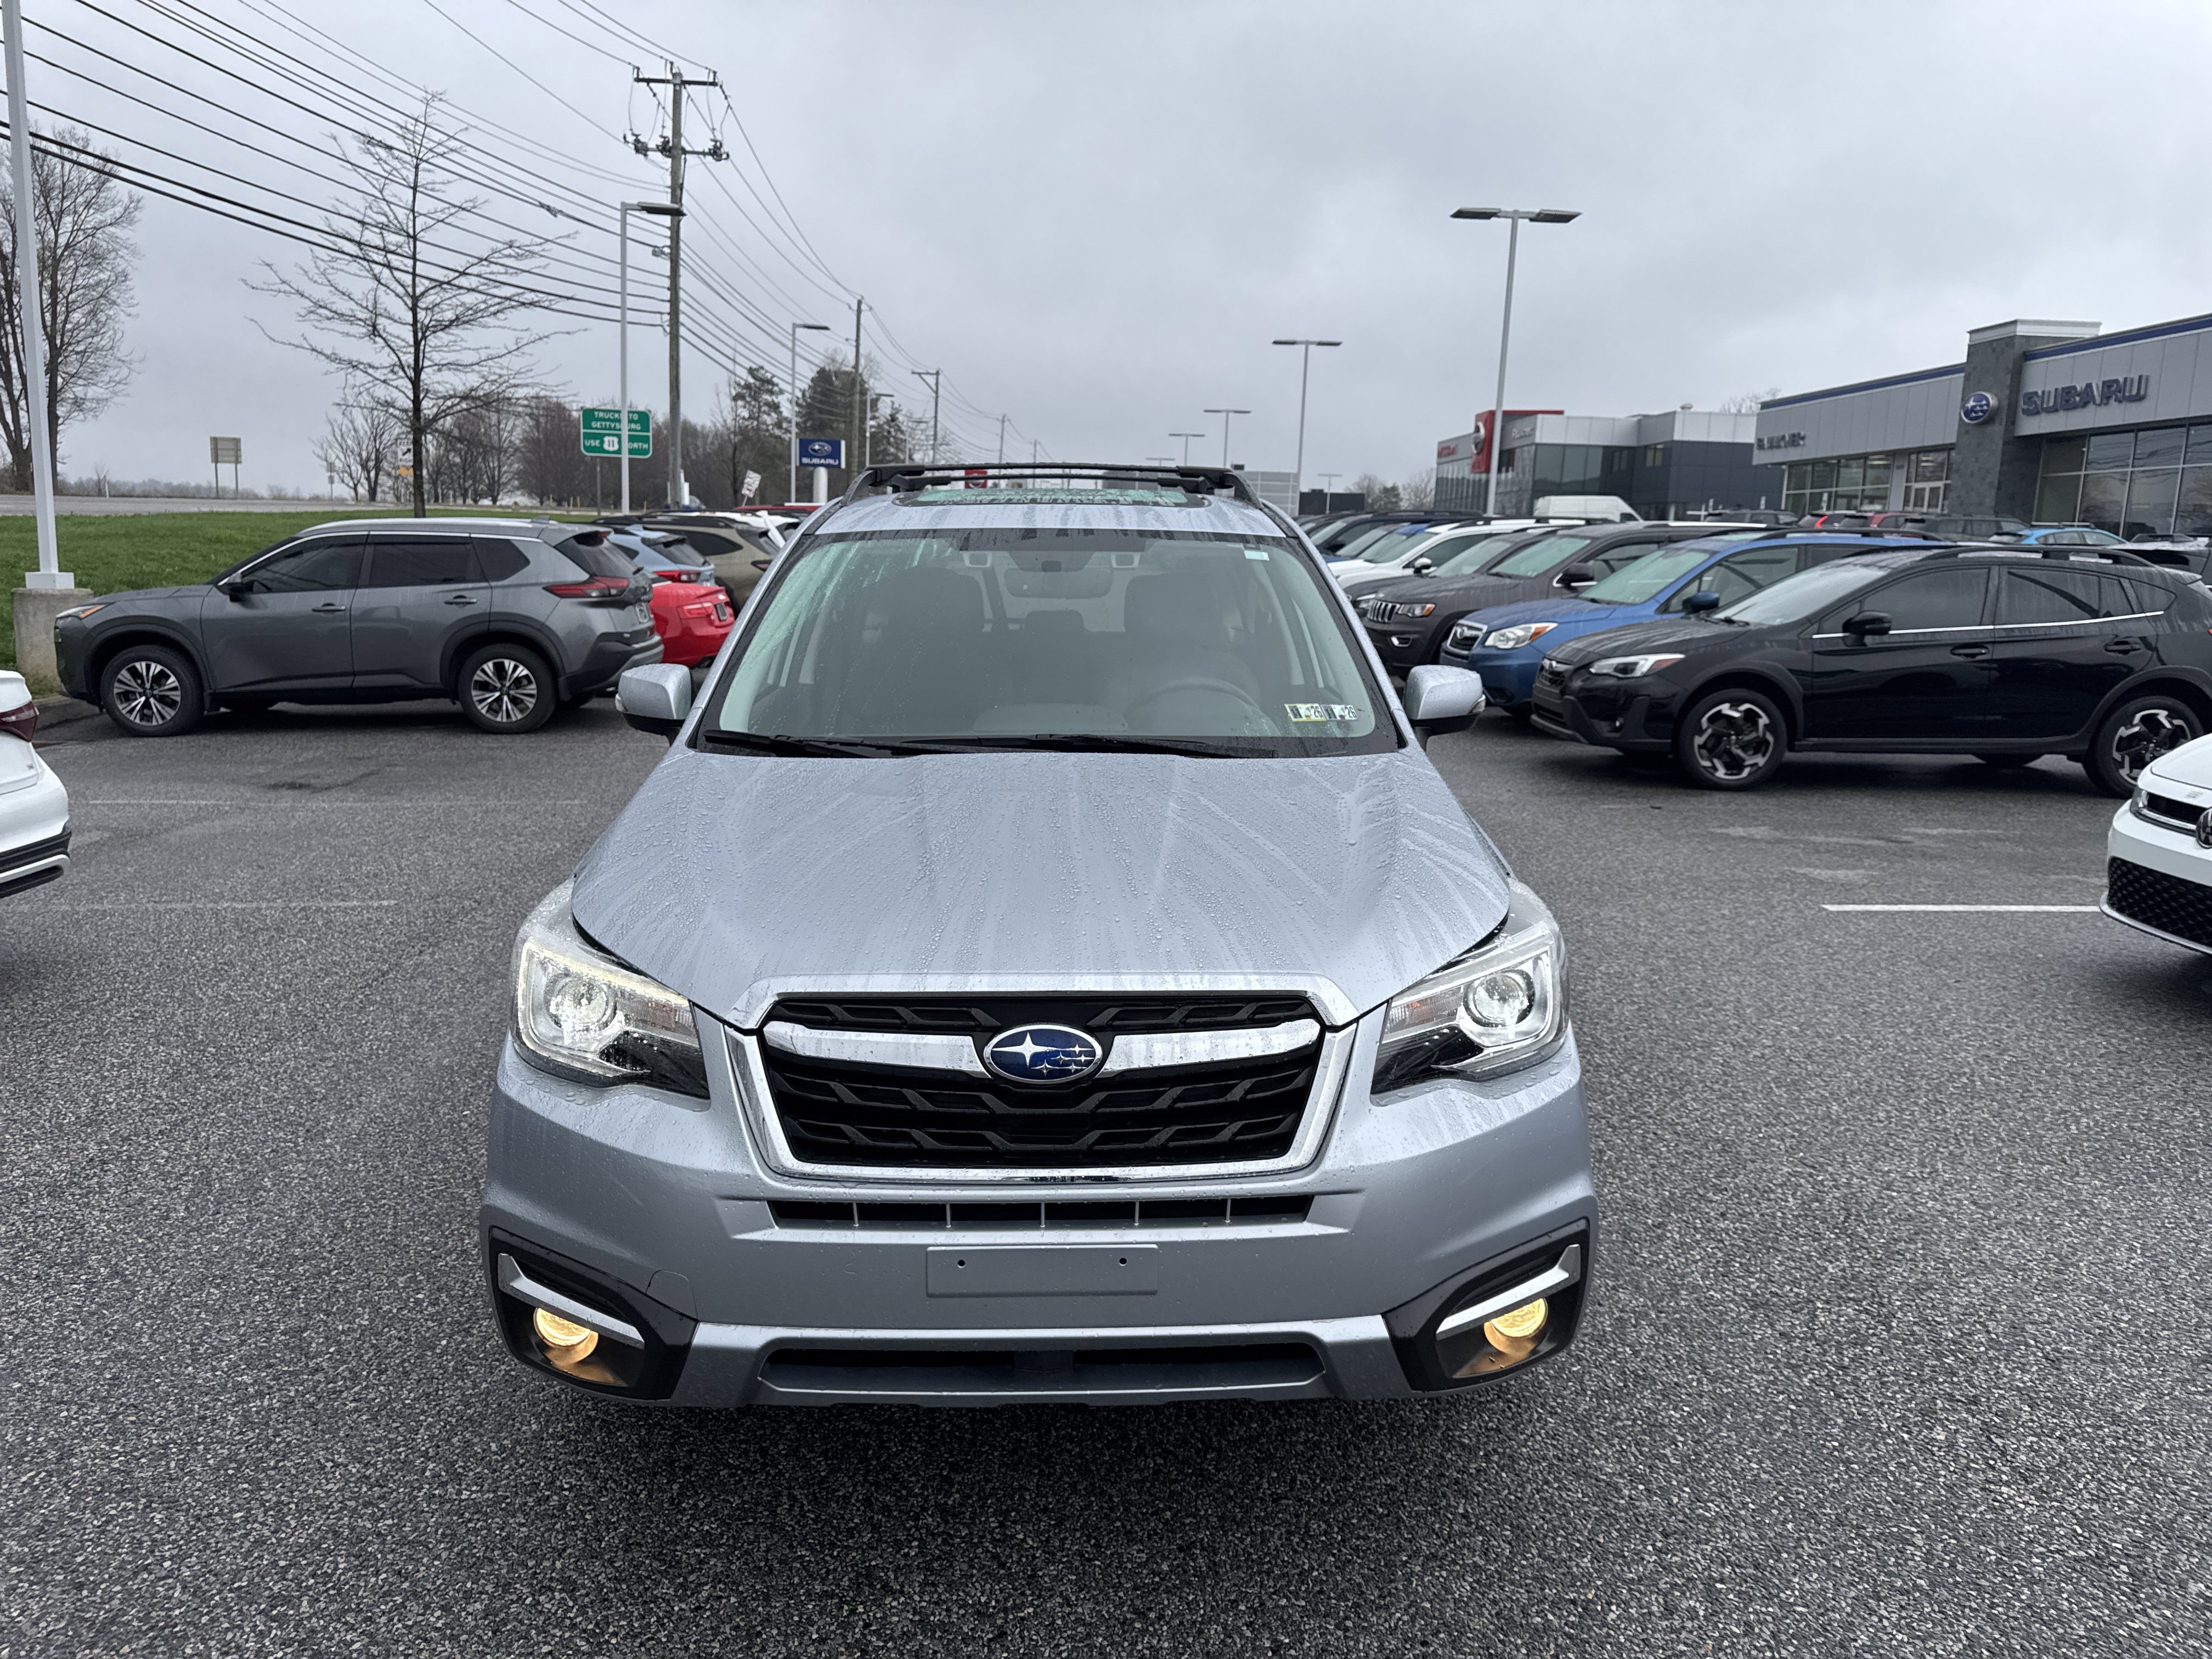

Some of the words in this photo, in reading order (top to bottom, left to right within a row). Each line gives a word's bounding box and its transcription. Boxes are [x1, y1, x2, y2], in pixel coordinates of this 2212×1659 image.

[2022, 374, 2149, 416] SUBARU
[608, 439, 614, 448] 11
[802, 457, 839, 465] SUBARU
[1311, 706, 1323, 718] 26
[1345, 706, 1357, 718] 26
